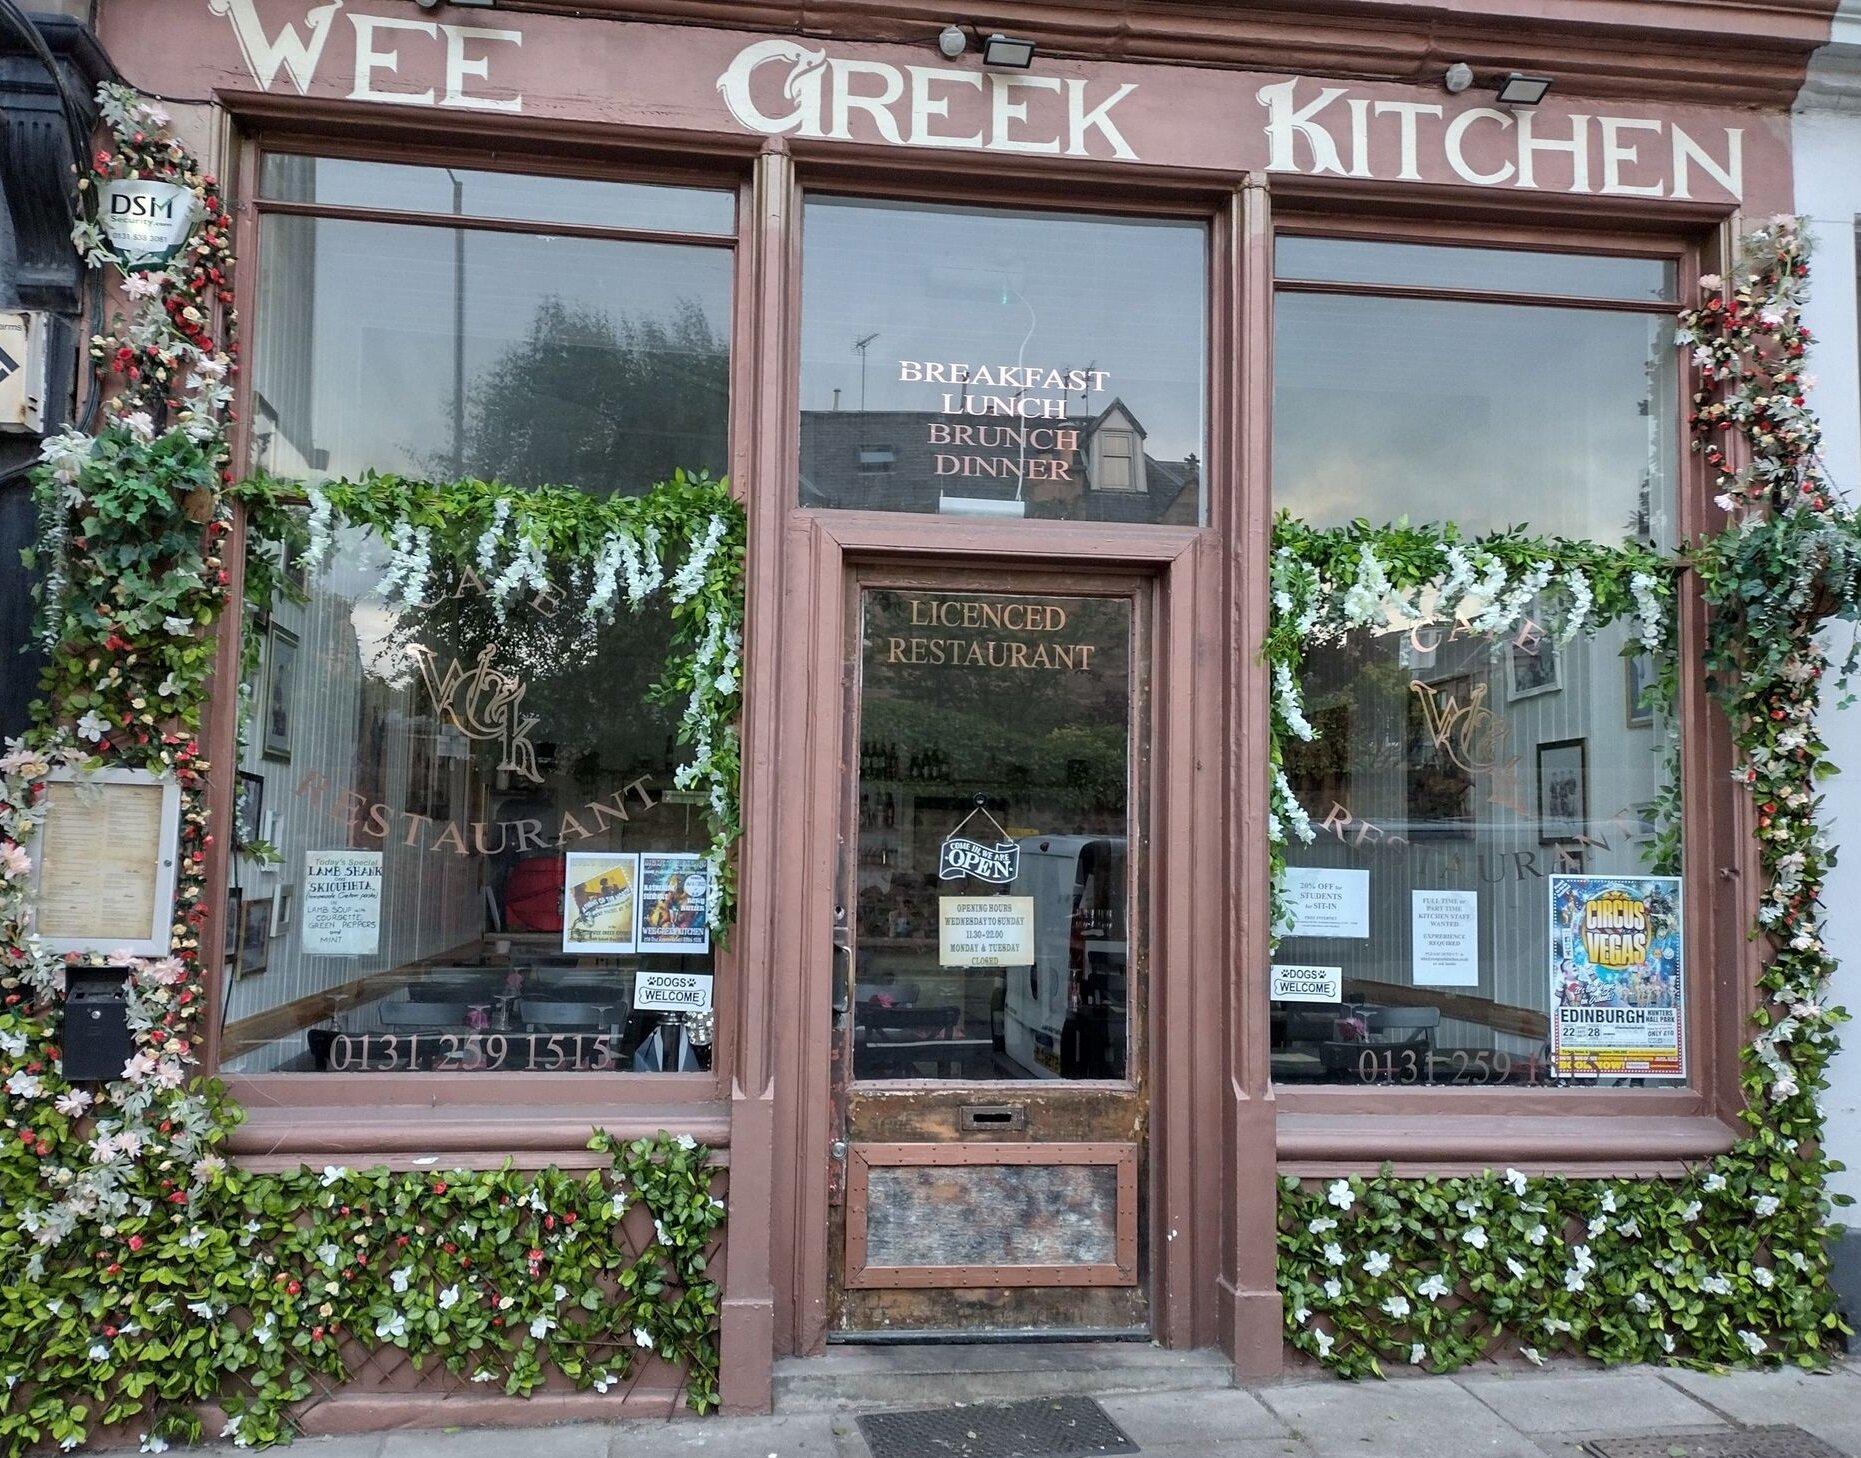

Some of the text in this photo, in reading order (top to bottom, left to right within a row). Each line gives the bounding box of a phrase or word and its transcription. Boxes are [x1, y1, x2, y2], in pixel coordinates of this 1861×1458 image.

[209, 0, 523, 113] WEE
[716, 40, 1140, 161] GREEK
[1256, 77, 1744, 202] KITCHEN
[110, 193, 179, 219] DSM
[899, 361, 1111, 392] BREAKFAST
[941, 394, 1068, 420] LUNCH
[927, 424, 1080, 451] BRUNCH
[933, 454, 1074, 481] DINNER
[909, 600, 1066, 632] LICENCED
[887, 637, 1095, 671] RESTAURANT
[294, 773, 656, 855] RESTAURANT
[948, 849, 1010, 877] OPEN
[950, 842, 971, 852] COME
[981, 851, 993, 859] WE
[994, 853, 1009, 861] ARE
[308, 866, 340, 876] LAMB
[1300, 892, 1343, 900] STUDENTS
[1317, 882, 1333, 890] OFF
[957, 904, 1012, 913] OPENING HOURS
[1313, 902, 1338, 910] SIT-IN
[1586, 899, 1645, 931] CIRCUS
[945, 917, 1024, 925] WEDNESDAY TO SUNDAY
[950, 944, 978, 953] MONDAY
[989, 944, 1020, 953] TUESDAY
[971, 957, 999, 965] CLOSED
[1586, 932, 1646, 965] VEGAS
[656, 977, 687, 988] DOGS
[1290, 969, 1317, 979] DOGS
[645, 990, 700, 1002] WELCOME
[1280, 982, 1330, 993] WELCOME
[1561, 1009, 1645, 1023] EDINBURGH
[1563, 1028, 1575, 1036] 22
[1588, 1028, 1600, 1037] 28
[330, 1034, 611, 1070] 0131 259 1515
[1358, 1049, 1439, 1085] 0131
[1450, 1050, 1511, 1085] 259
